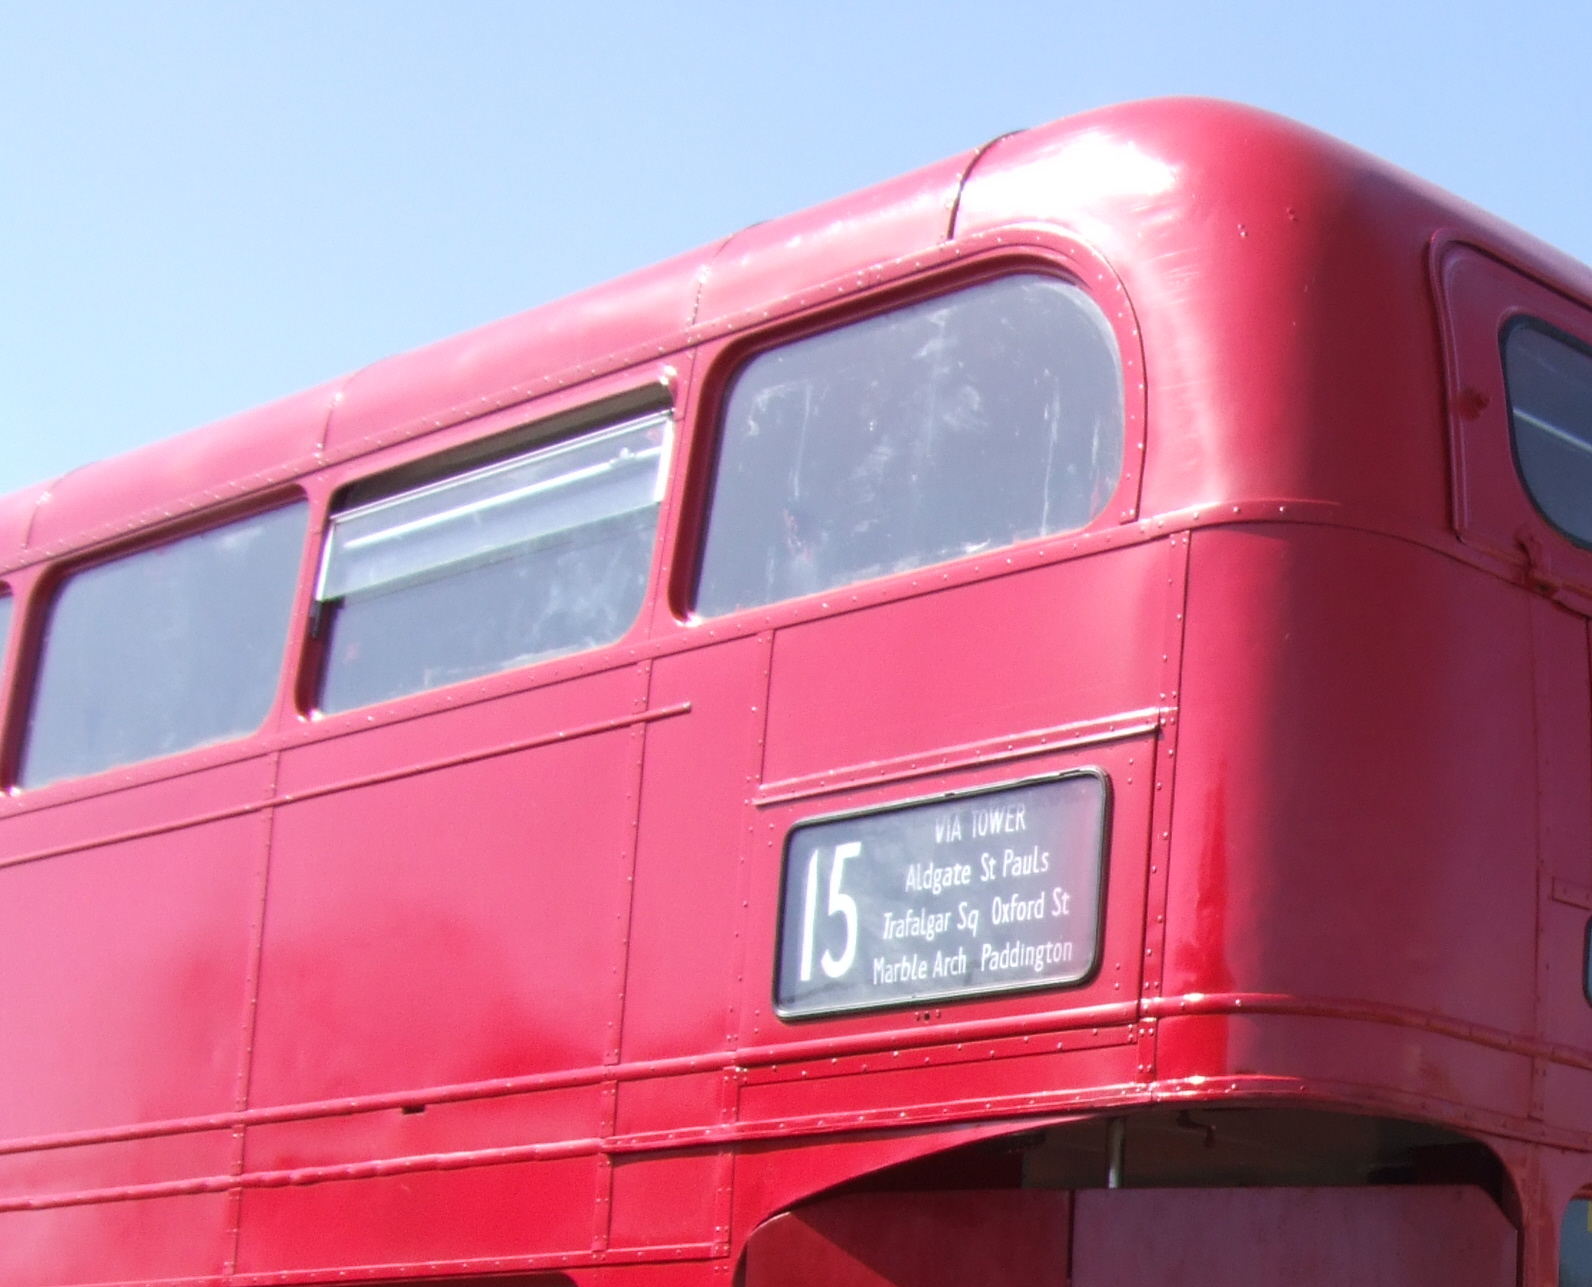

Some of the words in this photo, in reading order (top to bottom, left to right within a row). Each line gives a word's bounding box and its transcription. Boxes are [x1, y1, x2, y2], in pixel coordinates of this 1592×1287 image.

[934, 817, 962, 844] VIA
[971, 803, 1027, 837] TOWER
[905, 862, 971, 895] Aldgate
[980, 851, 996, 882] St
[1002, 845, 1049, 879] Pauls
[800, 841, 862, 982] 15
[881, 910, 951, 941] Trafalgar
[957, 902, 979, 937] Sq
[991, 891, 1044, 926] Oxford
[1051, 887, 1070, 916] St
[873, 956, 928, 985] Marble
[932, 947, 966, 978] Arch
[981, 939, 1073, 972] Paddington
